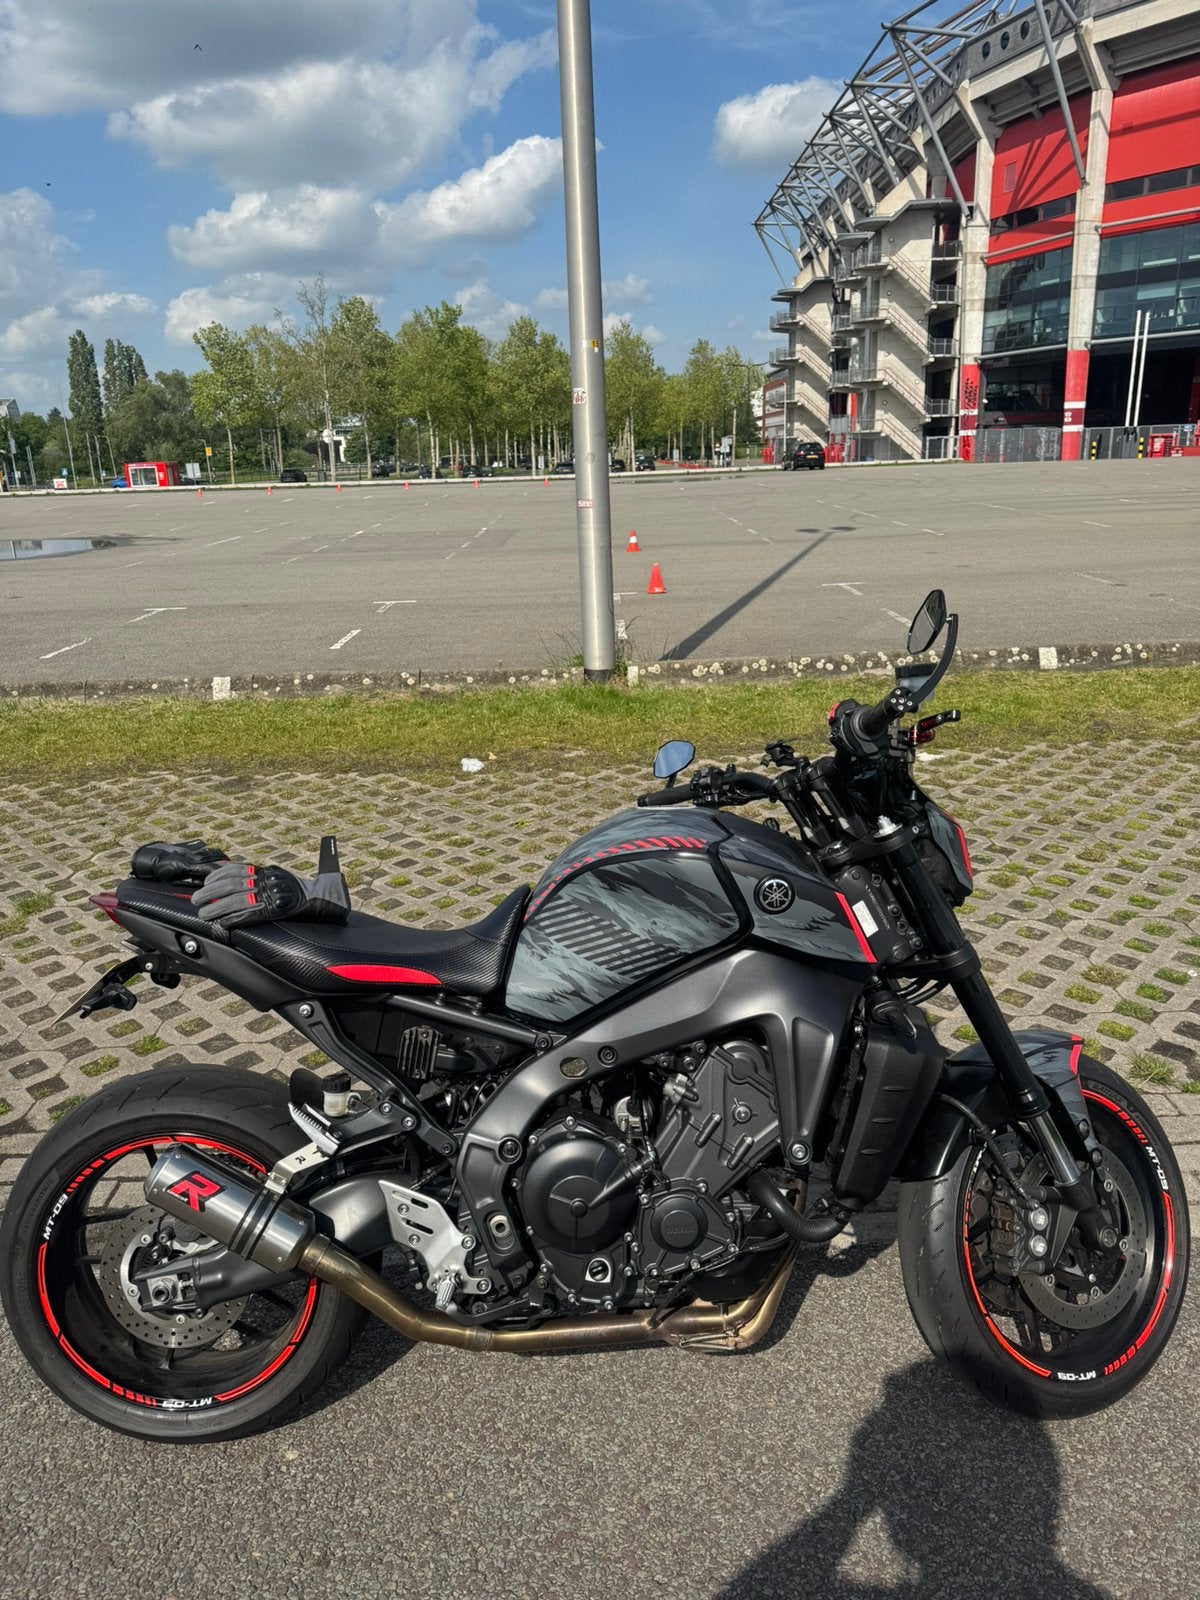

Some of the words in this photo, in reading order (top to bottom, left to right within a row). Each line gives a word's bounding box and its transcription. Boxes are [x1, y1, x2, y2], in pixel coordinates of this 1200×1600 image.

[1145, 1146, 1169, 1190] MT-09
[167, 1171, 223, 1212] R
[43, 1193, 69, 1240] MT-09
[1057, 1371, 1097, 1381] MT-09
[162, 1397, 213, 1408] MT-09
